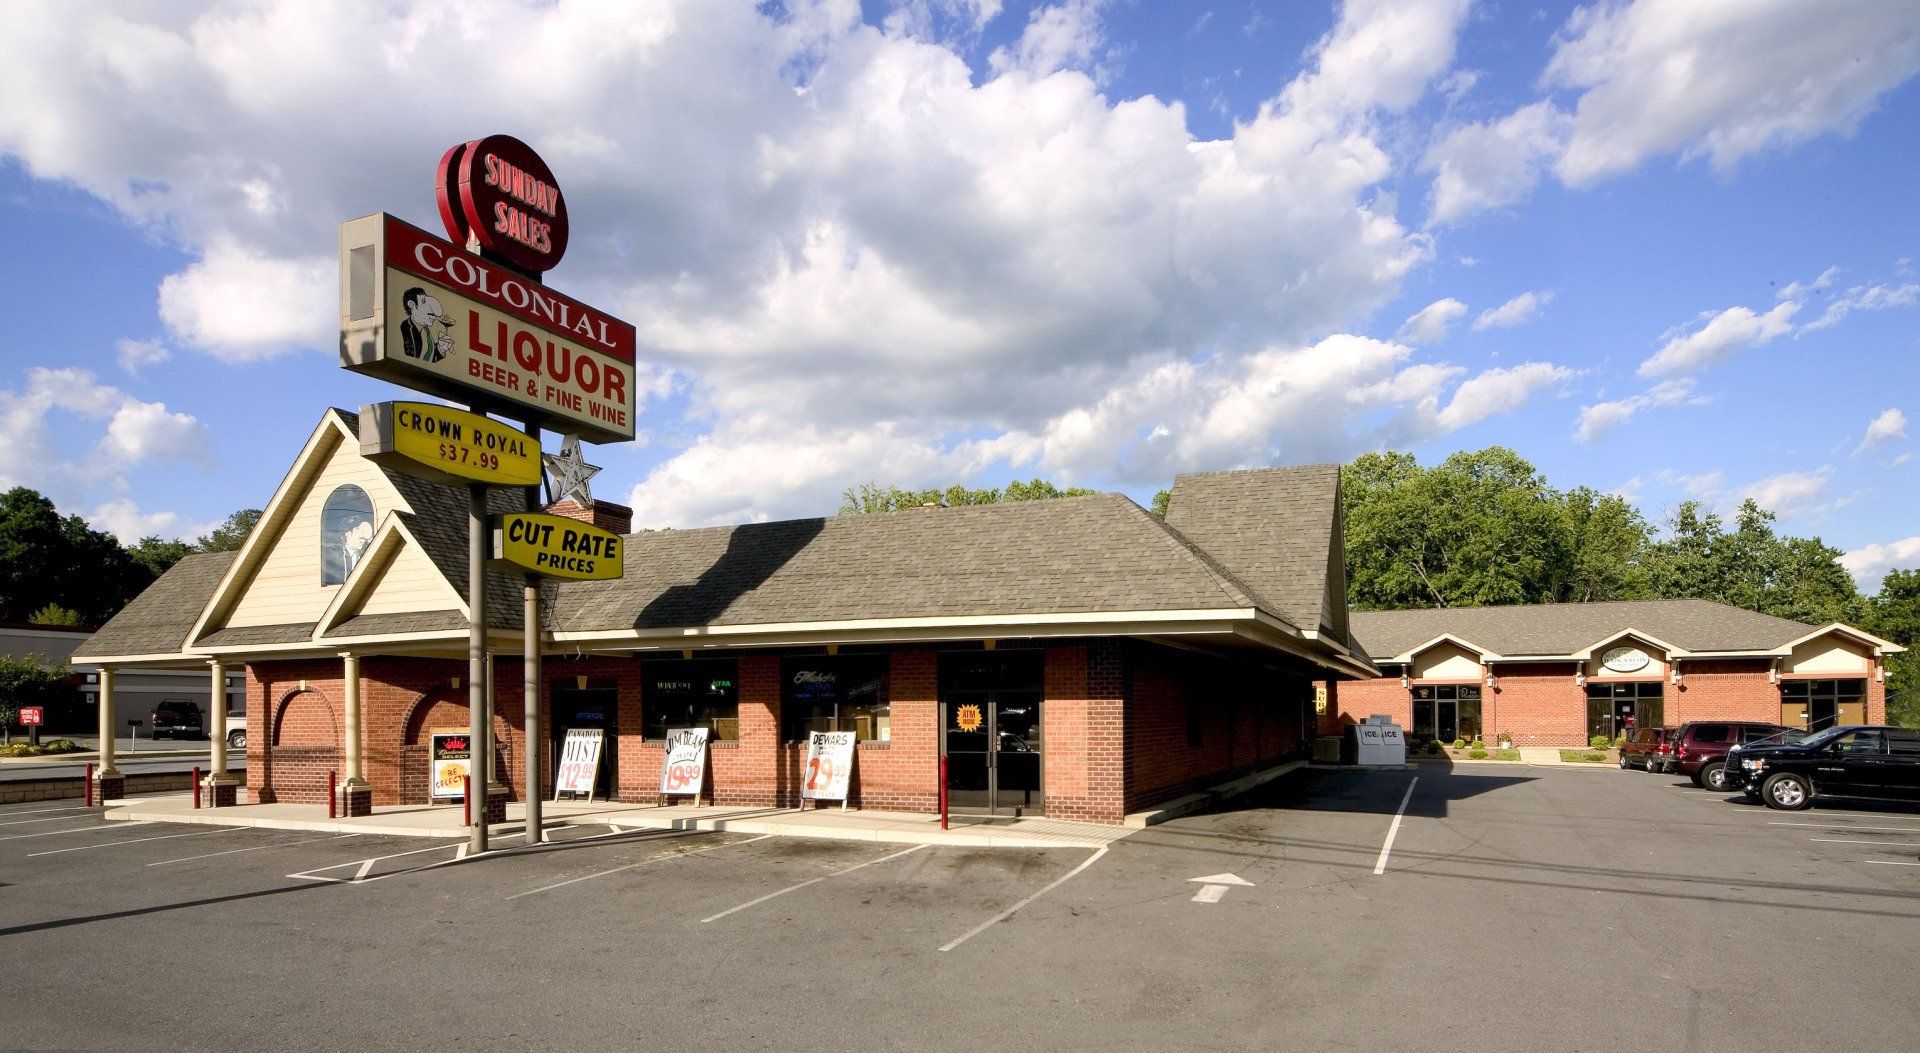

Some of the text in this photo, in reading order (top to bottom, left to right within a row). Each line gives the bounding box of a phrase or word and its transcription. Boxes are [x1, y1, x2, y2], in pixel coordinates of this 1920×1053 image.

[485, 153, 558, 218] SUNDAY
[494, 201, 552, 254] SALES
[415, 242, 617, 348] COLONIAL
[468, 310, 626, 405] LIQUOR
[468, 358, 626, 427] BEER & FINE WINE
[398, 410, 528, 458] CROWN ROYAL
[439, 442, 500, 471] $37.99
[508, 518, 618, 559] CUT RATE
[536, 552, 595, 574] PRICES
[568, 730, 602, 738] CANADIAN
[962, 710, 976, 719] ATM
[563, 740, 600, 762] MIST
[812, 734, 848, 746] DEWARS
